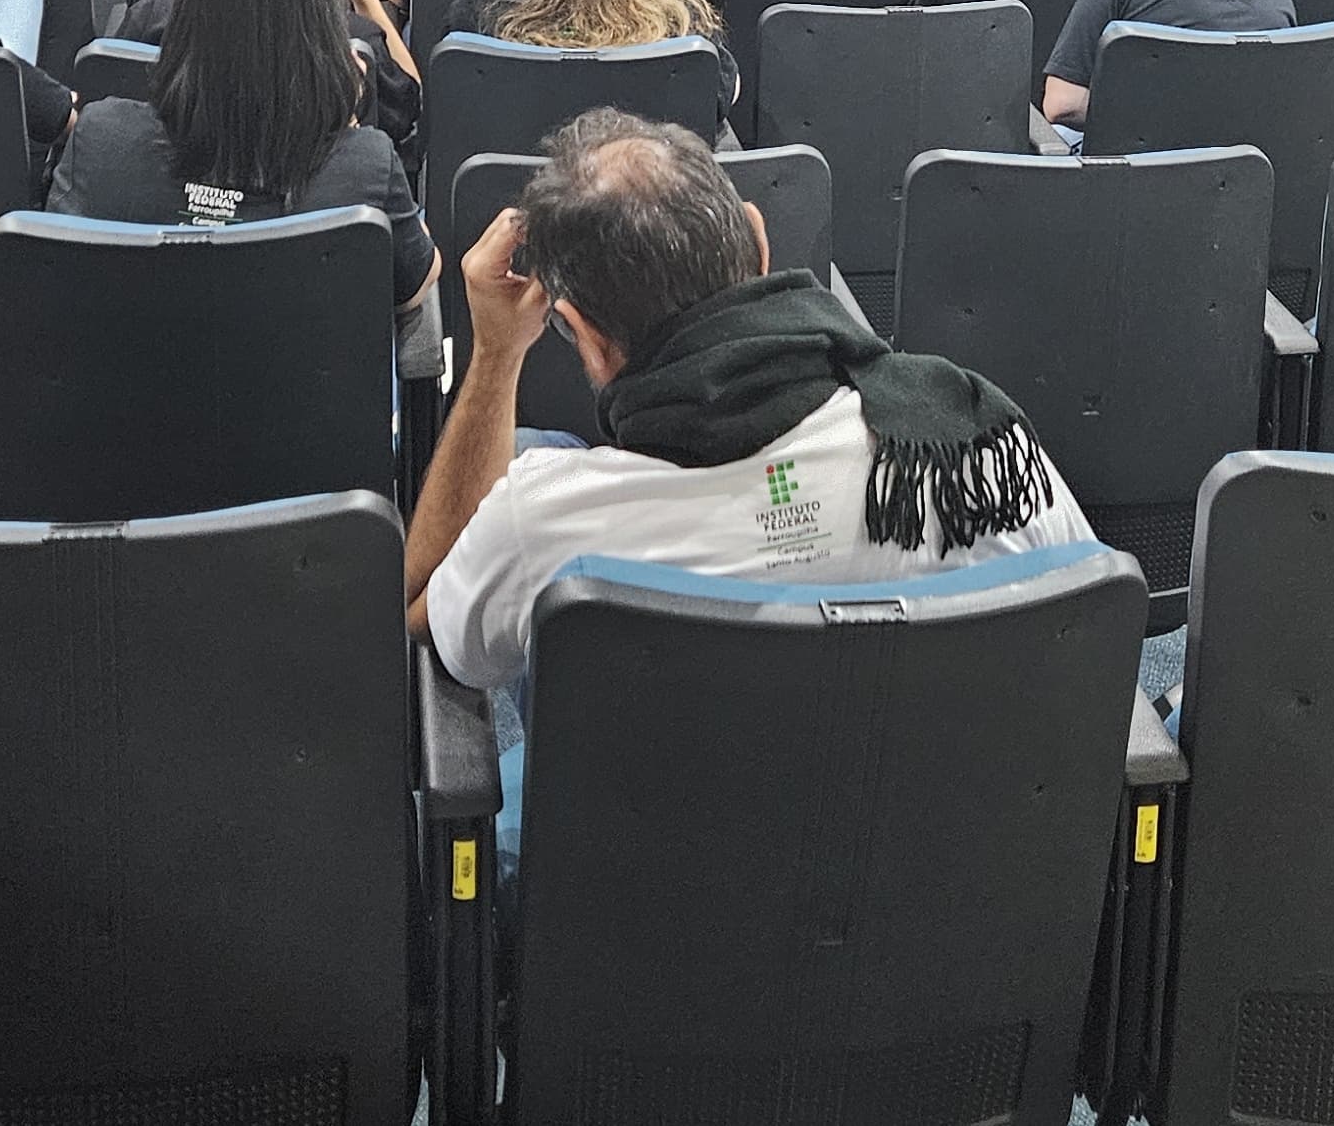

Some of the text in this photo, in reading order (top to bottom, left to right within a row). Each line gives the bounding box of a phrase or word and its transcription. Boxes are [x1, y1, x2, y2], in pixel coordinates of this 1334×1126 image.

[184, 182, 244, 202] INSTITUTO
[188, 193, 237, 210] FEDERAL
[755, 500, 821, 523] INSTITUTO
[763, 513, 818, 532] FEDERAL
